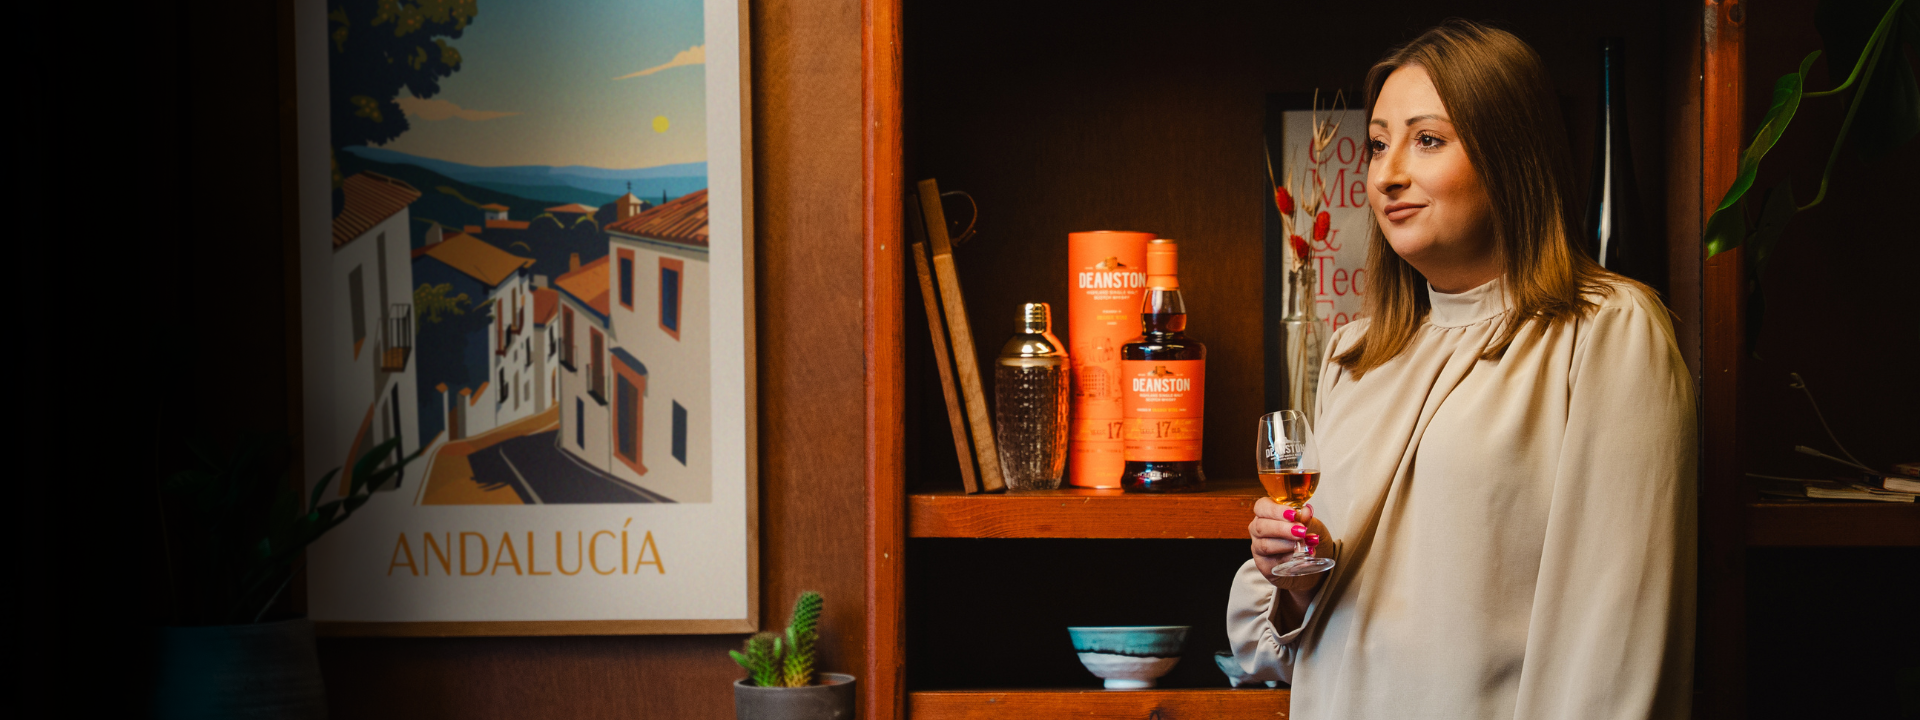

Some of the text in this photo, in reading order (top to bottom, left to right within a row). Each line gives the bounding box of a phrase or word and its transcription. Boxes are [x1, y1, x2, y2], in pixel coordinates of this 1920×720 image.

[1309, 168, 1369, 208] Me
[1312, 229, 1342, 252] &
[1078, 272, 1146, 289] DEANSTON
[1133, 378, 1190, 392] DEANSTON
[1107, 422, 1123, 439] 17
[1156, 421, 1171, 438] 17
[1265, 443, 1305, 458] DESTON
[387, 517, 666, 576] ANDALUCÍA
